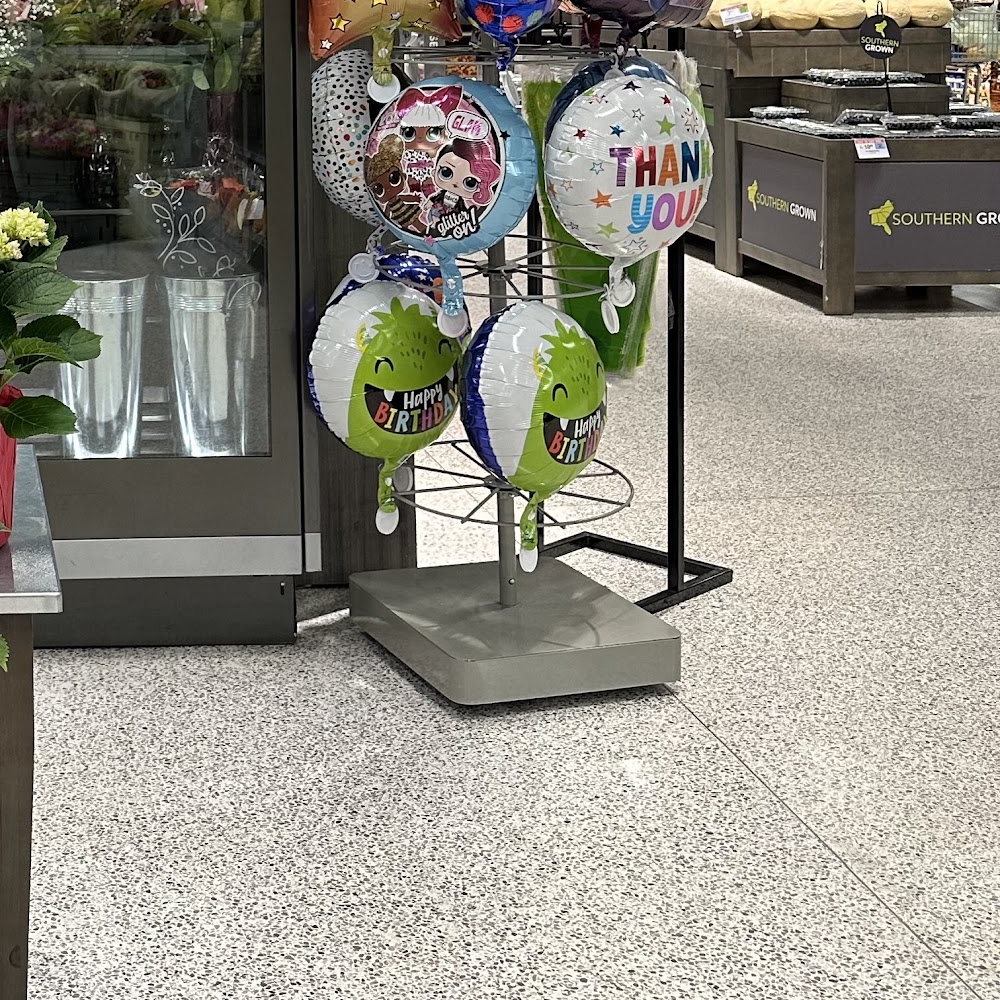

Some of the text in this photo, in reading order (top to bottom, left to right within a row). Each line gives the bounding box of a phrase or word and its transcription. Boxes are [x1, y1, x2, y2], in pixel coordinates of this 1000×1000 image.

[860, 35, 900, 48] SOUTHERN
[864, 43, 894, 54] GROWN
[756, 192, 817, 222] SOUTHERN GROWN
[892, 211, 1000, 226] SOUTHERN GRO
[436, 209, 471, 238] glitter
[451, 207, 479, 240] on!
[403, 382, 444, 410] Happy
[574, 411, 602, 439] Happy
[549, 428, 601, 465] BIRTHD
